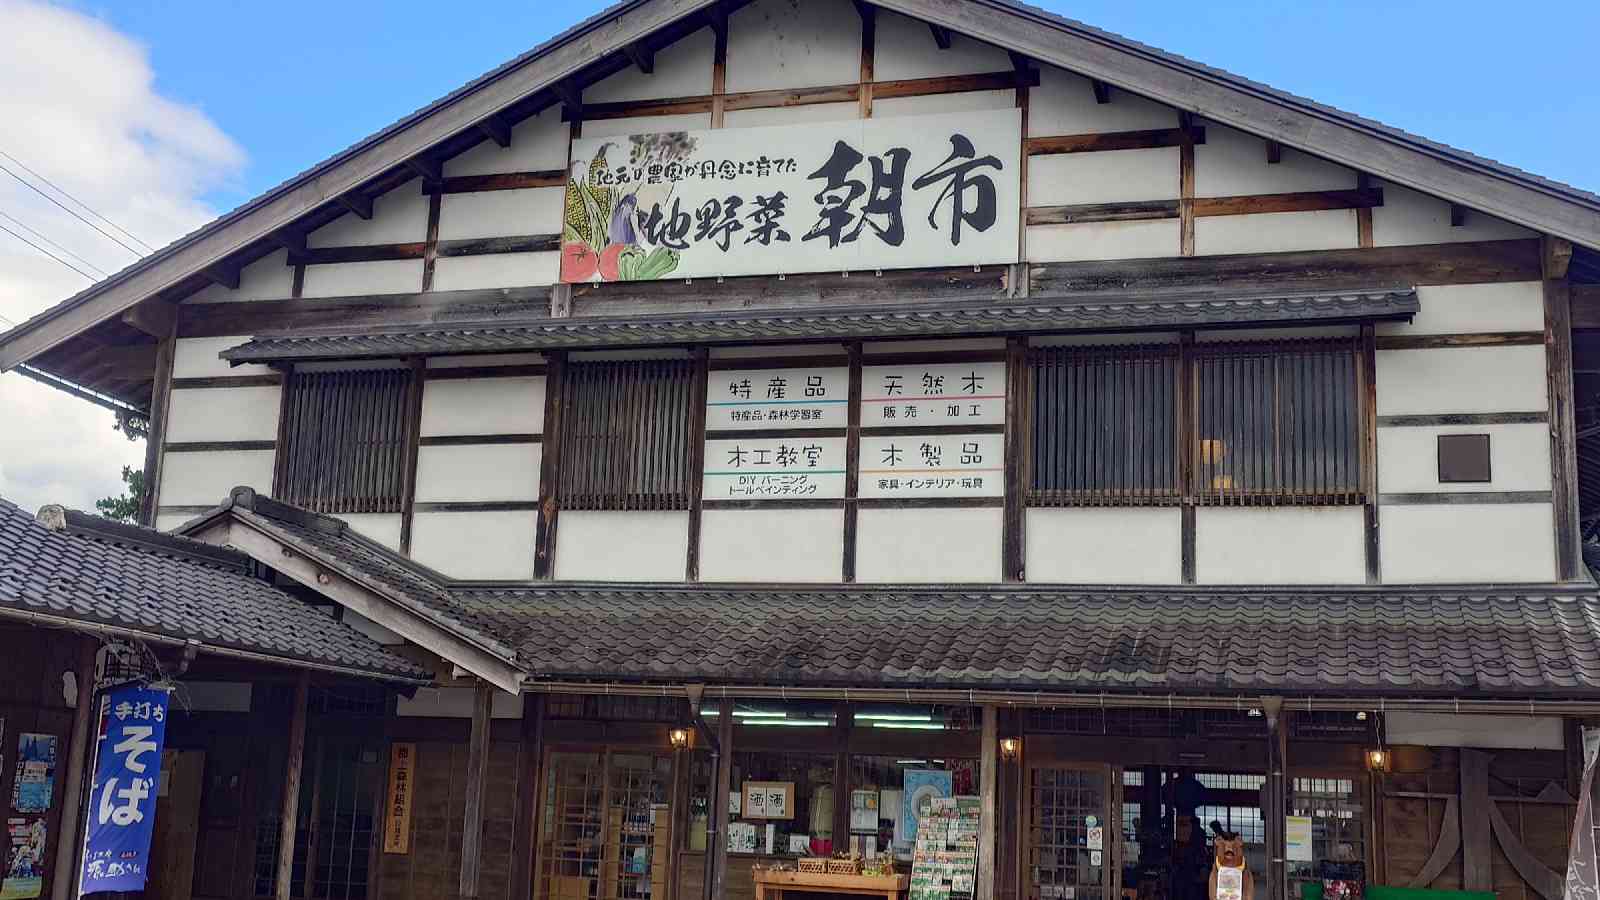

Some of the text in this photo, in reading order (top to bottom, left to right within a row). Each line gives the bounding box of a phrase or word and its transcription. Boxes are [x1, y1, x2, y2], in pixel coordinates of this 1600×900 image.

[801, 134, 1003, 248] 朝市
[637, 191, 791, 252] 地野菜
[729, 376, 826, 400] 特産品
[884, 371, 985, 396] 天然木
[730, 408, 823, 422] 特産品・森林学習室
[883, 404, 982, 419] 販売・加工
[727, 444, 823, 468] 木工教室
[881, 442, 983, 467] 木製品
[739, 475, 756, 486] DIY
[878, 478, 983, 490] 家具・インテリア・玩具
[114, 701, 164, 722] 手打ち
[98, 726, 157, 826] そば
